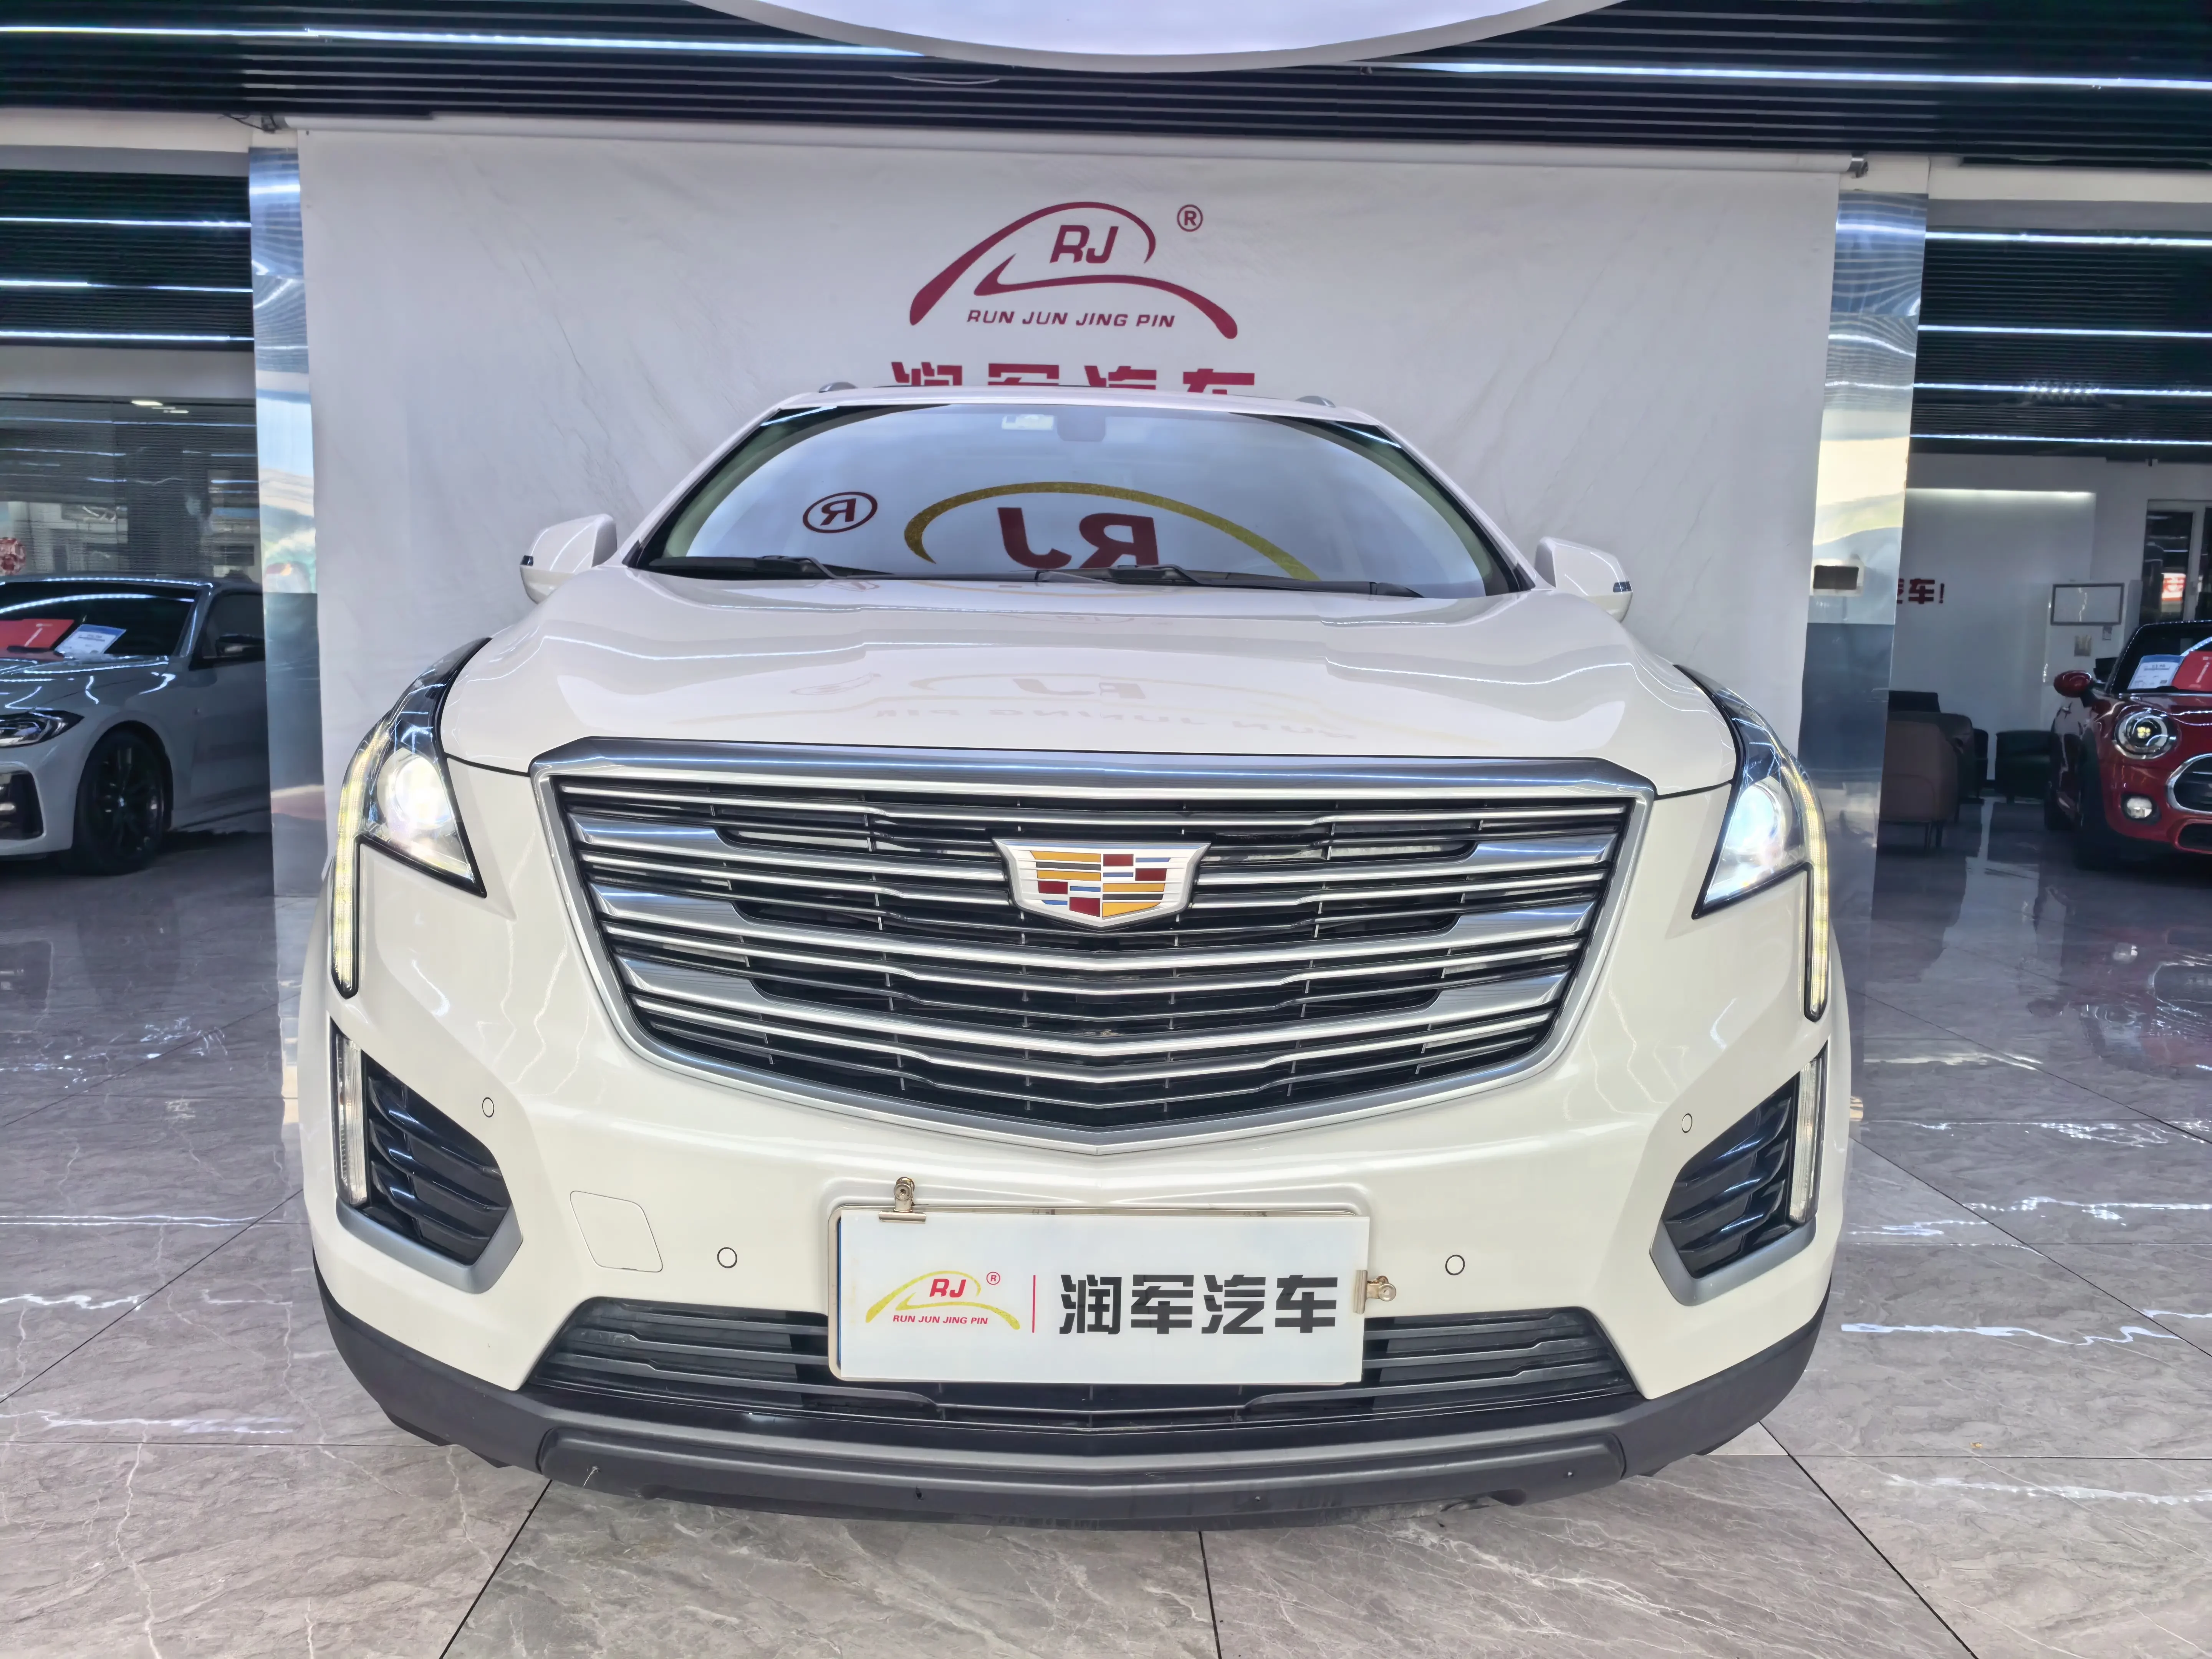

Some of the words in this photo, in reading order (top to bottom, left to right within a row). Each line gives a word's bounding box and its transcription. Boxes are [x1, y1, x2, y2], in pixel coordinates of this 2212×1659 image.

[1049, 225, 1119, 263] RJ
[967, 310, 1015, 324] RUN
[1022, 311, 1068, 325] JUN
[1075, 313, 1128, 327] JING
[1136, 314, 1175, 328] PIN
[929, 1278, 967, 1298] RJ
[1059, 1274, 1338, 1335] 润军汽车
[892, 1315, 916, 1323] RUN
[943, 1316, 968, 1325] JING
